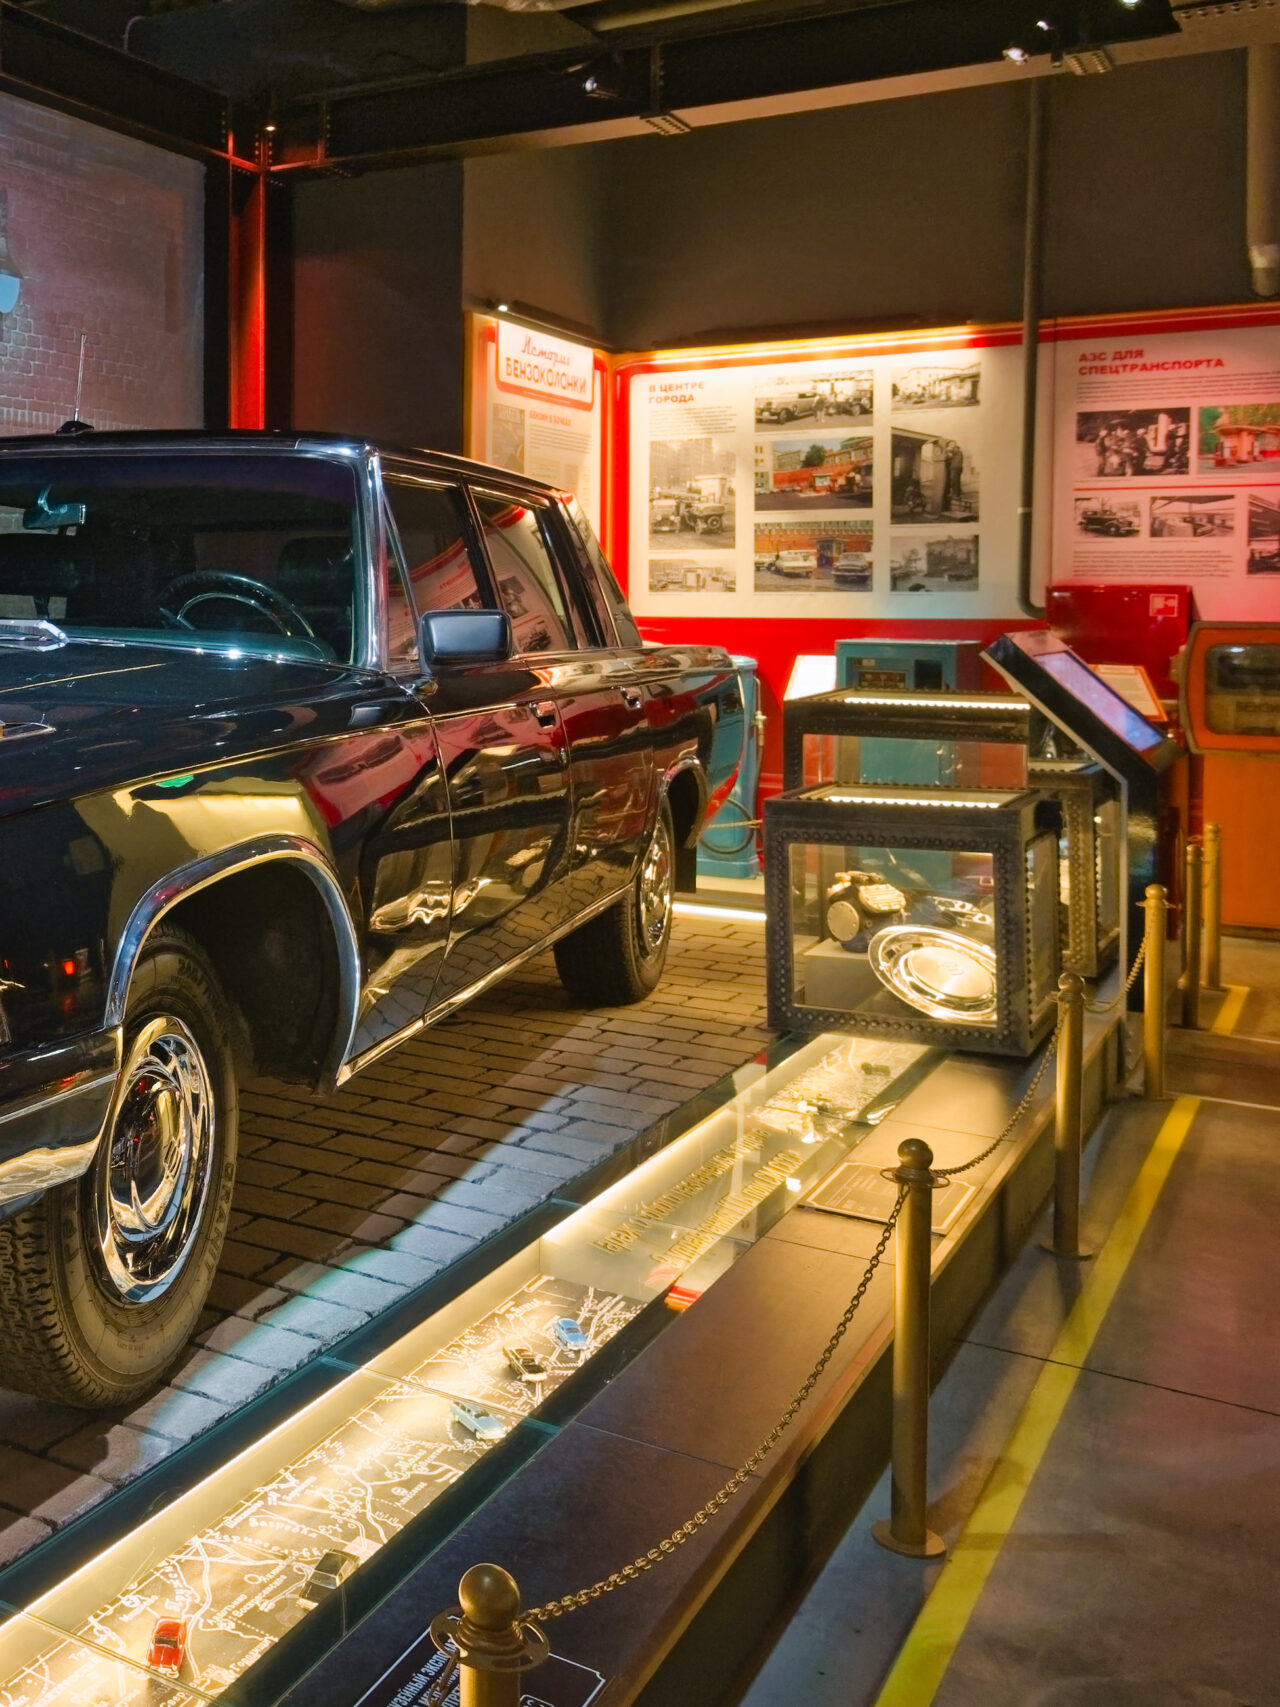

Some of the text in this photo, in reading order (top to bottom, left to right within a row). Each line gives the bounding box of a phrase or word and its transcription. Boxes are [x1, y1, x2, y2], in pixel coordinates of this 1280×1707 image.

[1078, 349, 1145, 363] АЗС ДЛЯ
[1078, 358, 1225, 376] СПЕЦТРАНСПОРТА
[505, 356, 587, 395] БЕНЗОКОЛОНКИ
[659, 382, 705, 393] ЦЕНТРЕ
[648, 394, 695, 404] ГОРОДА
